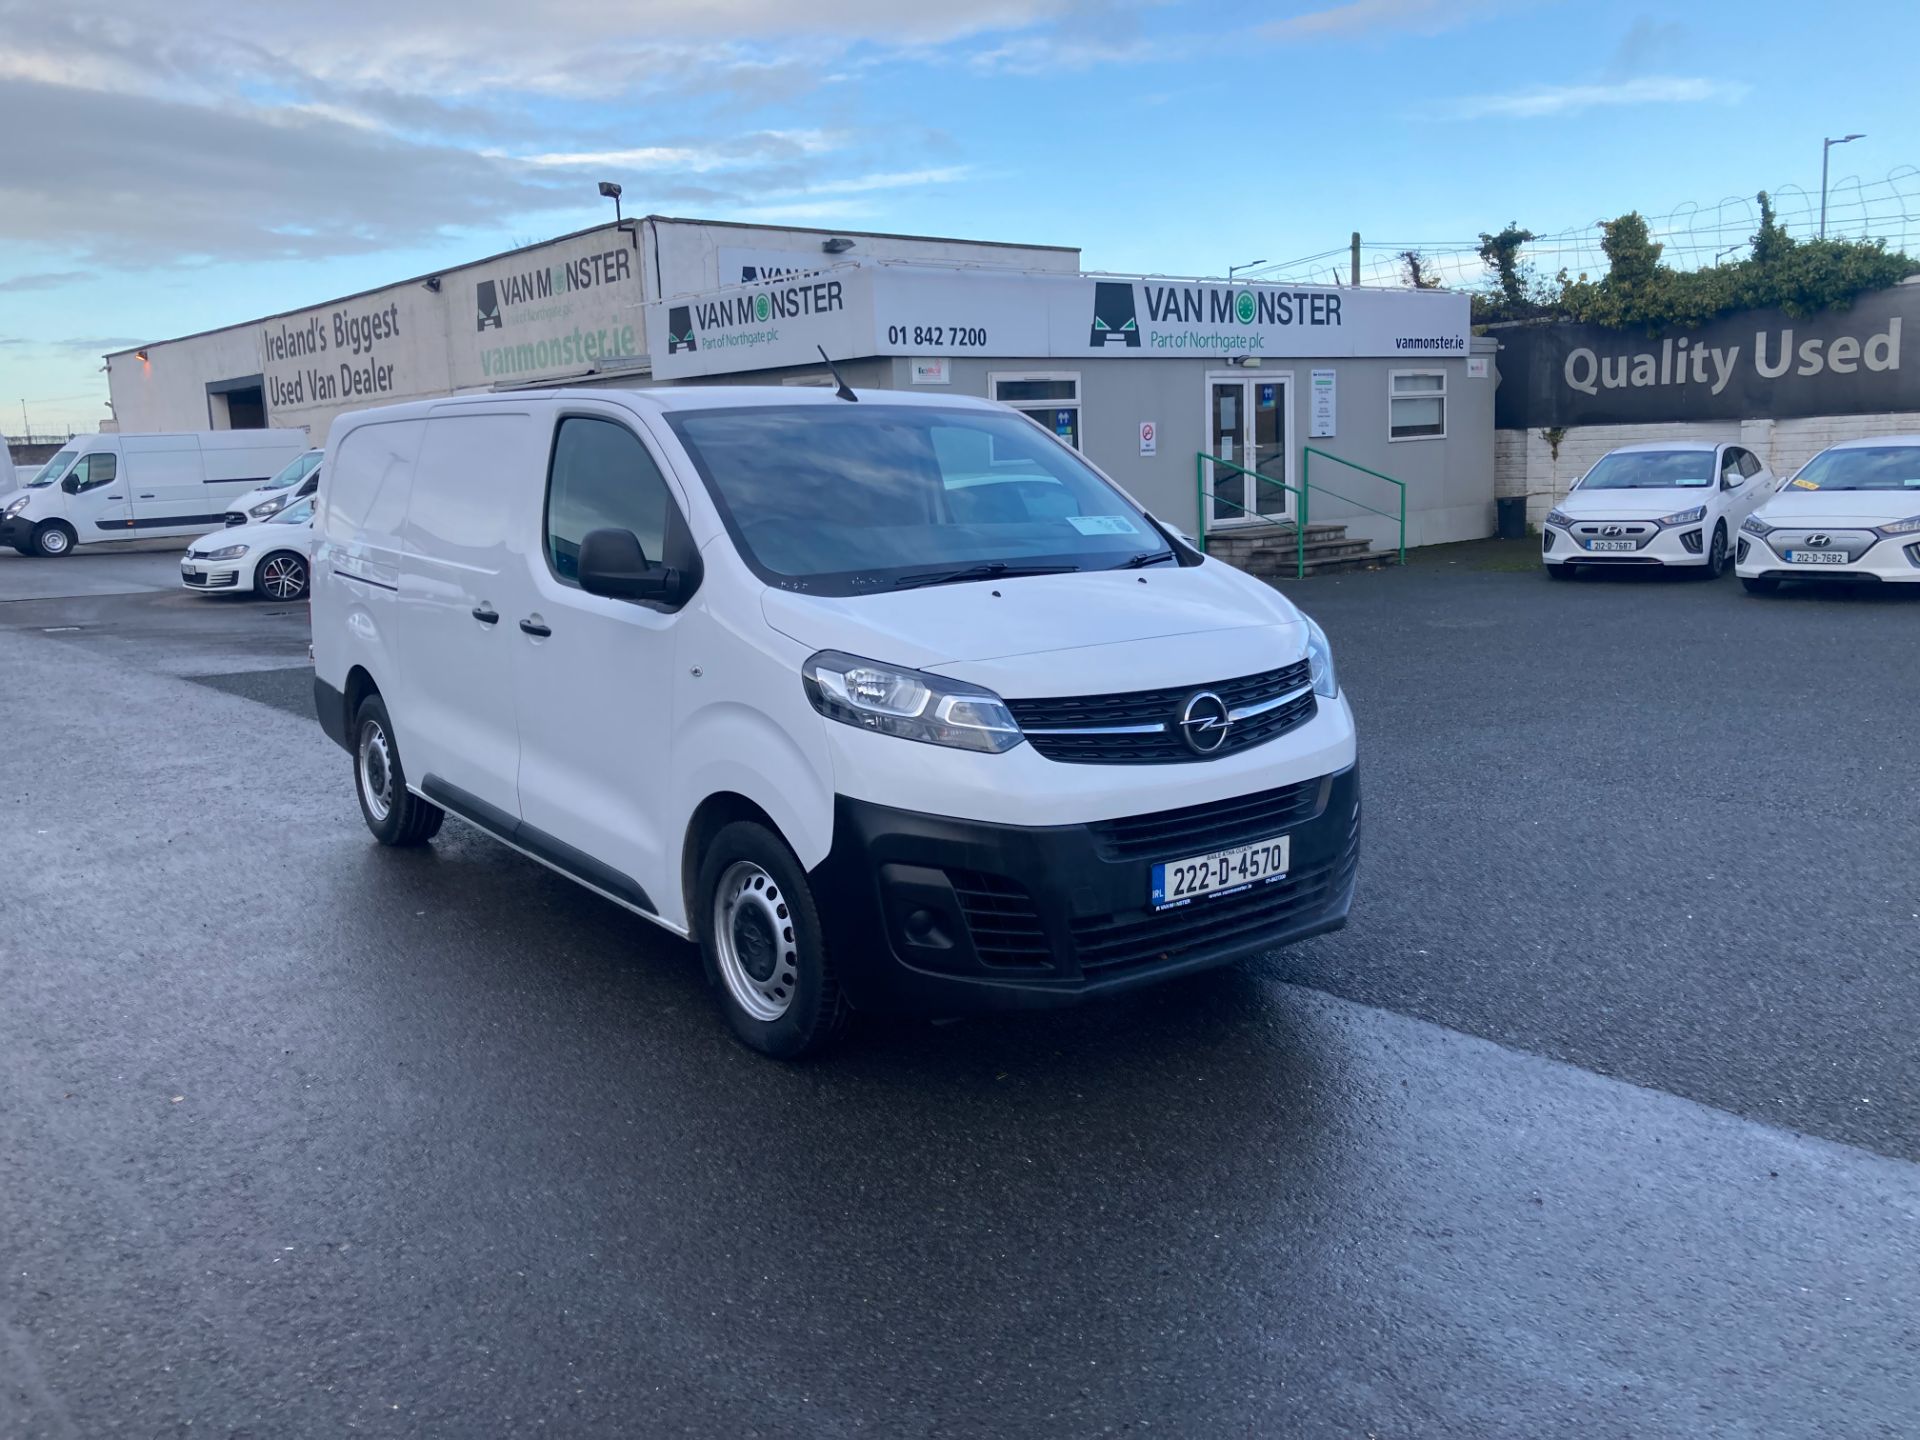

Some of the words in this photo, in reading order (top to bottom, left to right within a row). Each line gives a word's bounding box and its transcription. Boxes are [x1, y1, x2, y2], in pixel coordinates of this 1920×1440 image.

[500, 272, 534, 306] VAN
[536, 248, 631, 299] MONSTER
[695, 299, 734, 330] VAN
[737, 281, 843, 325] MONSTER
[1144, 286, 1203, 323] VAN
[1210, 289, 1342, 326] MONSTER
[264, 317, 327, 362] Ireland's
[333, 302, 400, 355] Biggest
[480, 314, 636, 377] vanmonster.ie
[702, 337, 716, 351] Part
[717, 337, 726, 348] of
[726, 331, 765, 348] Northgate
[766, 328, 779, 346] plc
[888, 325, 907, 345] 01
[913, 326, 944, 346] 842
[948, 327, 987, 346] 7200
[1151, 331, 1174, 348] Part
[1175, 330, 1189, 348] of
[1189, 331, 1247, 353] Northgate
[1249, 332, 1265, 353] plc
[1395, 334, 1464, 350] vanmonster.ie
[1564, 336, 1740, 396] Quality
[1754, 316, 1903, 379] Used
[269, 370, 304, 407] Used
[307, 369, 337, 401] Van
[340, 356, 394, 397] Dealer
[1796, 553, 1843, 563] 212-D-7682
[1173, 844, 1282, 897] 222-D-4570
[1152, 888, 1164, 899] IRL
